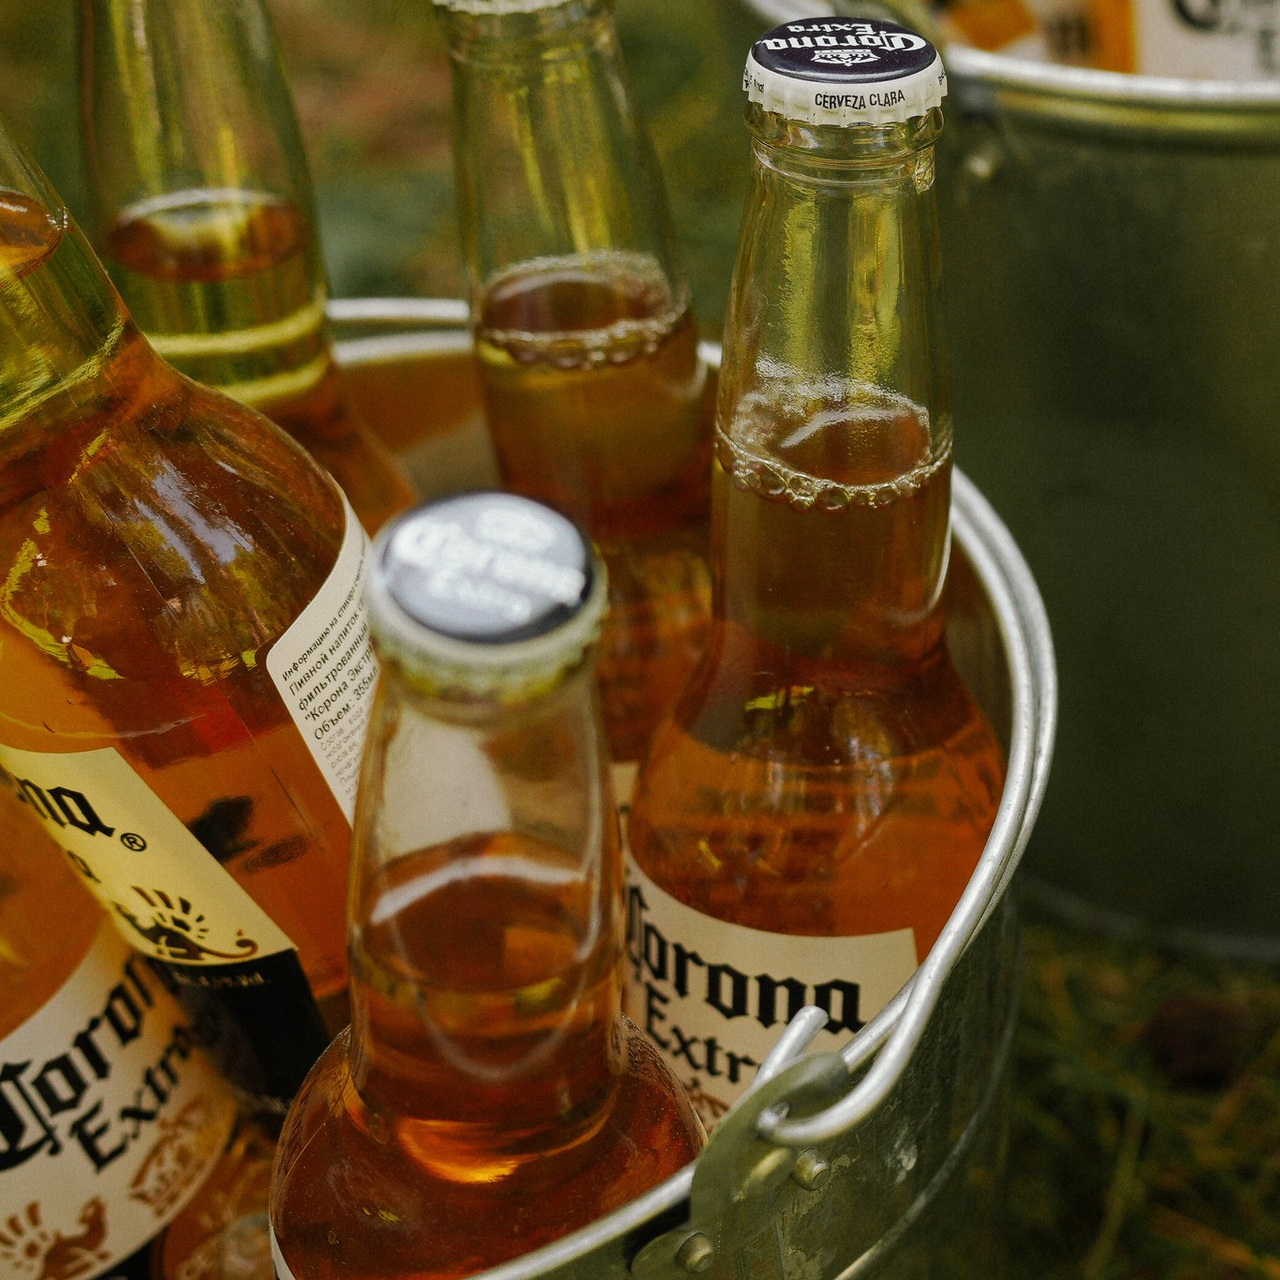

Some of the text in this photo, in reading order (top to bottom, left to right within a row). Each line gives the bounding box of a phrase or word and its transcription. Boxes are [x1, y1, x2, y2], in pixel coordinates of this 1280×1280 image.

[757, 32, 927, 52] Corona
[787, 23, 873, 36] Extra
[815, 89, 905, 110] CERVEZA CLARA
[282, 625, 331, 682] Информацию
[289, 652, 330, 696] Пивной
[645, 981, 763, 1084] Extr
